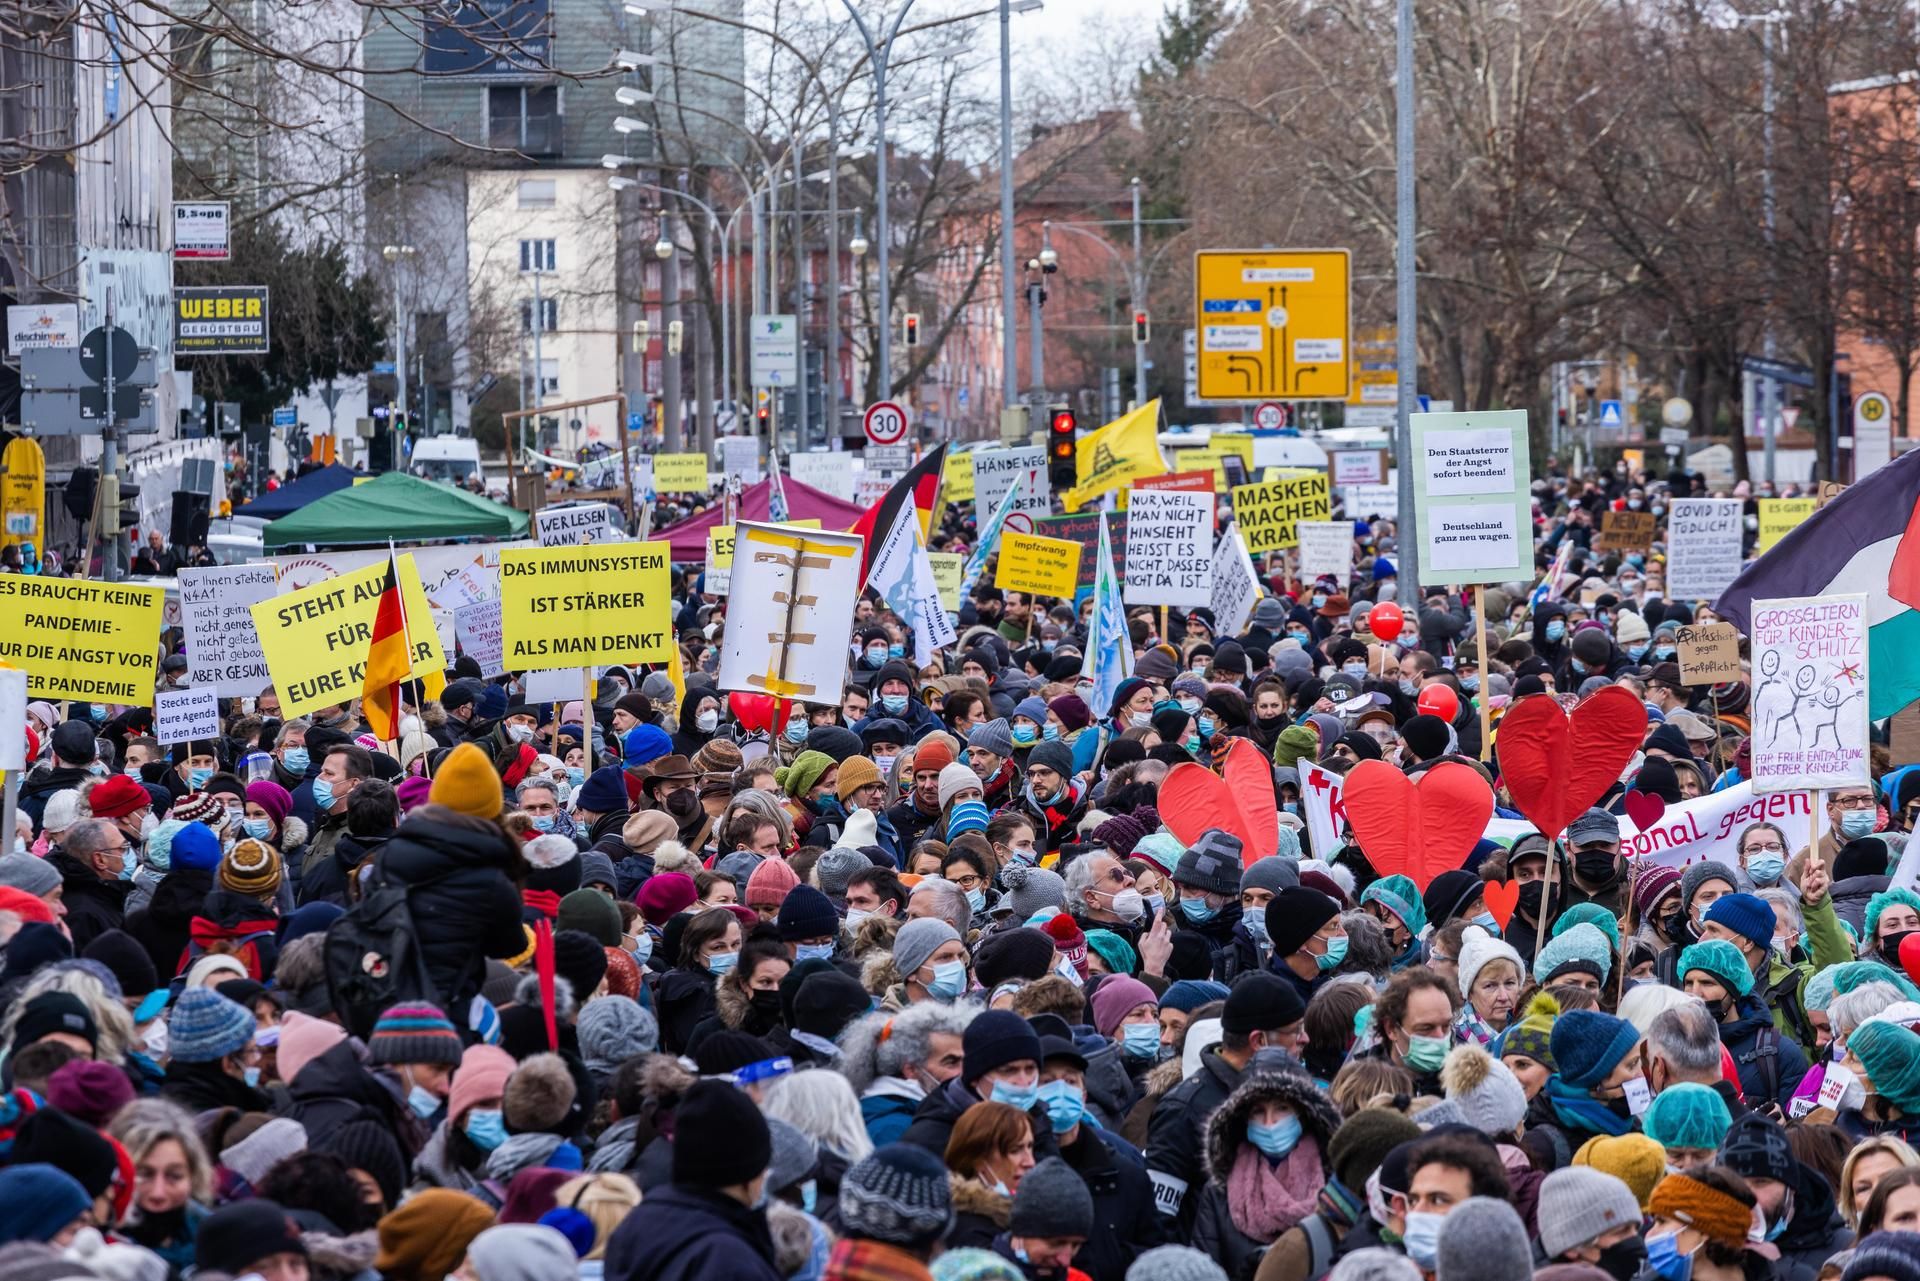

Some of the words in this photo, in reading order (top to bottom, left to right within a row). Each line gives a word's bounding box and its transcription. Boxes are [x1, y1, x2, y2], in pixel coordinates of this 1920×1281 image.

[180, 298, 262, 319] WEBER
[182, 323, 260, 334] GERÜSTBAU
[180, 338, 215, 346] FREIBURG
[874, 415, 897, 433] 30
[1260, 410, 1280, 424] 30
[1428, 448, 1448, 457] Den
[1449, 447, 1510, 457] Staatsterror
[976, 457, 1020, 475] HÄNDE
[1022, 455, 1046, 468] WEG
[1446, 458, 1462, 467] der
[1463, 458, 1492, 468] Angst
[1433, 469, 1462, 479] sofort
[1464, 468, 1507, 477] beenden!
[1238, 478, 1326, 507] MASKEN
[988, 496, 1046, 514] KDERN
[1674, 504, 1713, 518] COVID
[1717, 503, 1739, 517] IST
[540, 515, 568, 533] WER
[571, 509, 606, 526] LESEN
[1130, 510, 1161, 521] MAN
[1165, 509, 1206, 523] NICHT
[1239, 499, 1329, 529] MACHEN
[1130, 525, 1196, 539] HINSIEHT
[1442, 521, 1503, 531] Deutschland
[1249, 525, 1298, 547] KRA
[1434, 534, 1458, 544] ganz
[1459, 534, 1477, 542] neu
[1479, 532, 1512, 545] wagen.
[1014, 540, 1067, 557] Impfzwang
[1127, 543, 1172, 556] HEISST
[1177, 543, 1195, 556] ES
[503, 561, 538, 577] DAS
[541, 555, 664, 575] IMMUNSYSTEM
[873, 549, 893, 582] Freiheit
[183, 575, 199, 588] Vor
[202, 571, 232, 586] Ihnen
[1126, 574, 1153, 587] NICHT
[1156, 574, 1173, 588] DA
[0, 580, 16, 595] ES
[20, 582, 100, 602] BRAUCHT
[103, 590, 152, 607] KEINE
[278, 589, 346, 628] STEHT
[530, 597, 559, 613] IST
[563, 592, 645, 612] STÄRKER
[194, 605, 219, 619] nicht
[930, 593, 950, 636] Freiheit
[1754, 603, 1860, 629] GROSSELTERN
[24, 614, 112, 634] PANDEMIE
[195, 619, 220, 634] nicht
[224, 618, 255, 634] genes
[197, 632, 225, 648] nicht
[228, 632, 259, 649] getest
[325, 622, 372, 651] FÜR
[479, 629, 502, 641] ZWAN
[1755, 629, 1785, 646] FÜR
[1789, 622, 1855, 642] KINDER-
[513, 638, 548, 656] ALS
[552, 636, 596, 654] MAN
[601, 632, 664, 652] DENKT
[1695, 645, 1718, 655] gegen
[1795, 636, 1861, 660] SCHUTZ
[0, 642, 22, 657] UR
[26, 644, 54, 660] DIE
[57, 647, 114, 666] ANGST
[118, 652, 153, 668] VOR
[198, 648, 226, 662] nicht
[192, 668, 224, 682] ABER
[482, 666, 498, 678] TOP
[27, 675, 45, 689] ER
[49, 677, 136, 697] PANDEMIE
[287, 669, 346, 704] EURE
[161, 697, 190, 709] Steckt
[192, 693, 213, 704] euch
[1331, 689, 1348, 701] CR
[160, 713, 181, 725] eure
[184, 710, 216, 724] Agenda
[160, 730, 170, 740] in
[173, 728, 190, 740] den
[191, 723, 217, 736] Arsch
[1755, 763, 1801, 776] UNSERER
[1806, 761, 1851, 775] KINDER
[1620, 811, 1709, 858] sonal
[1715, 793, 1811, 841] gegen
